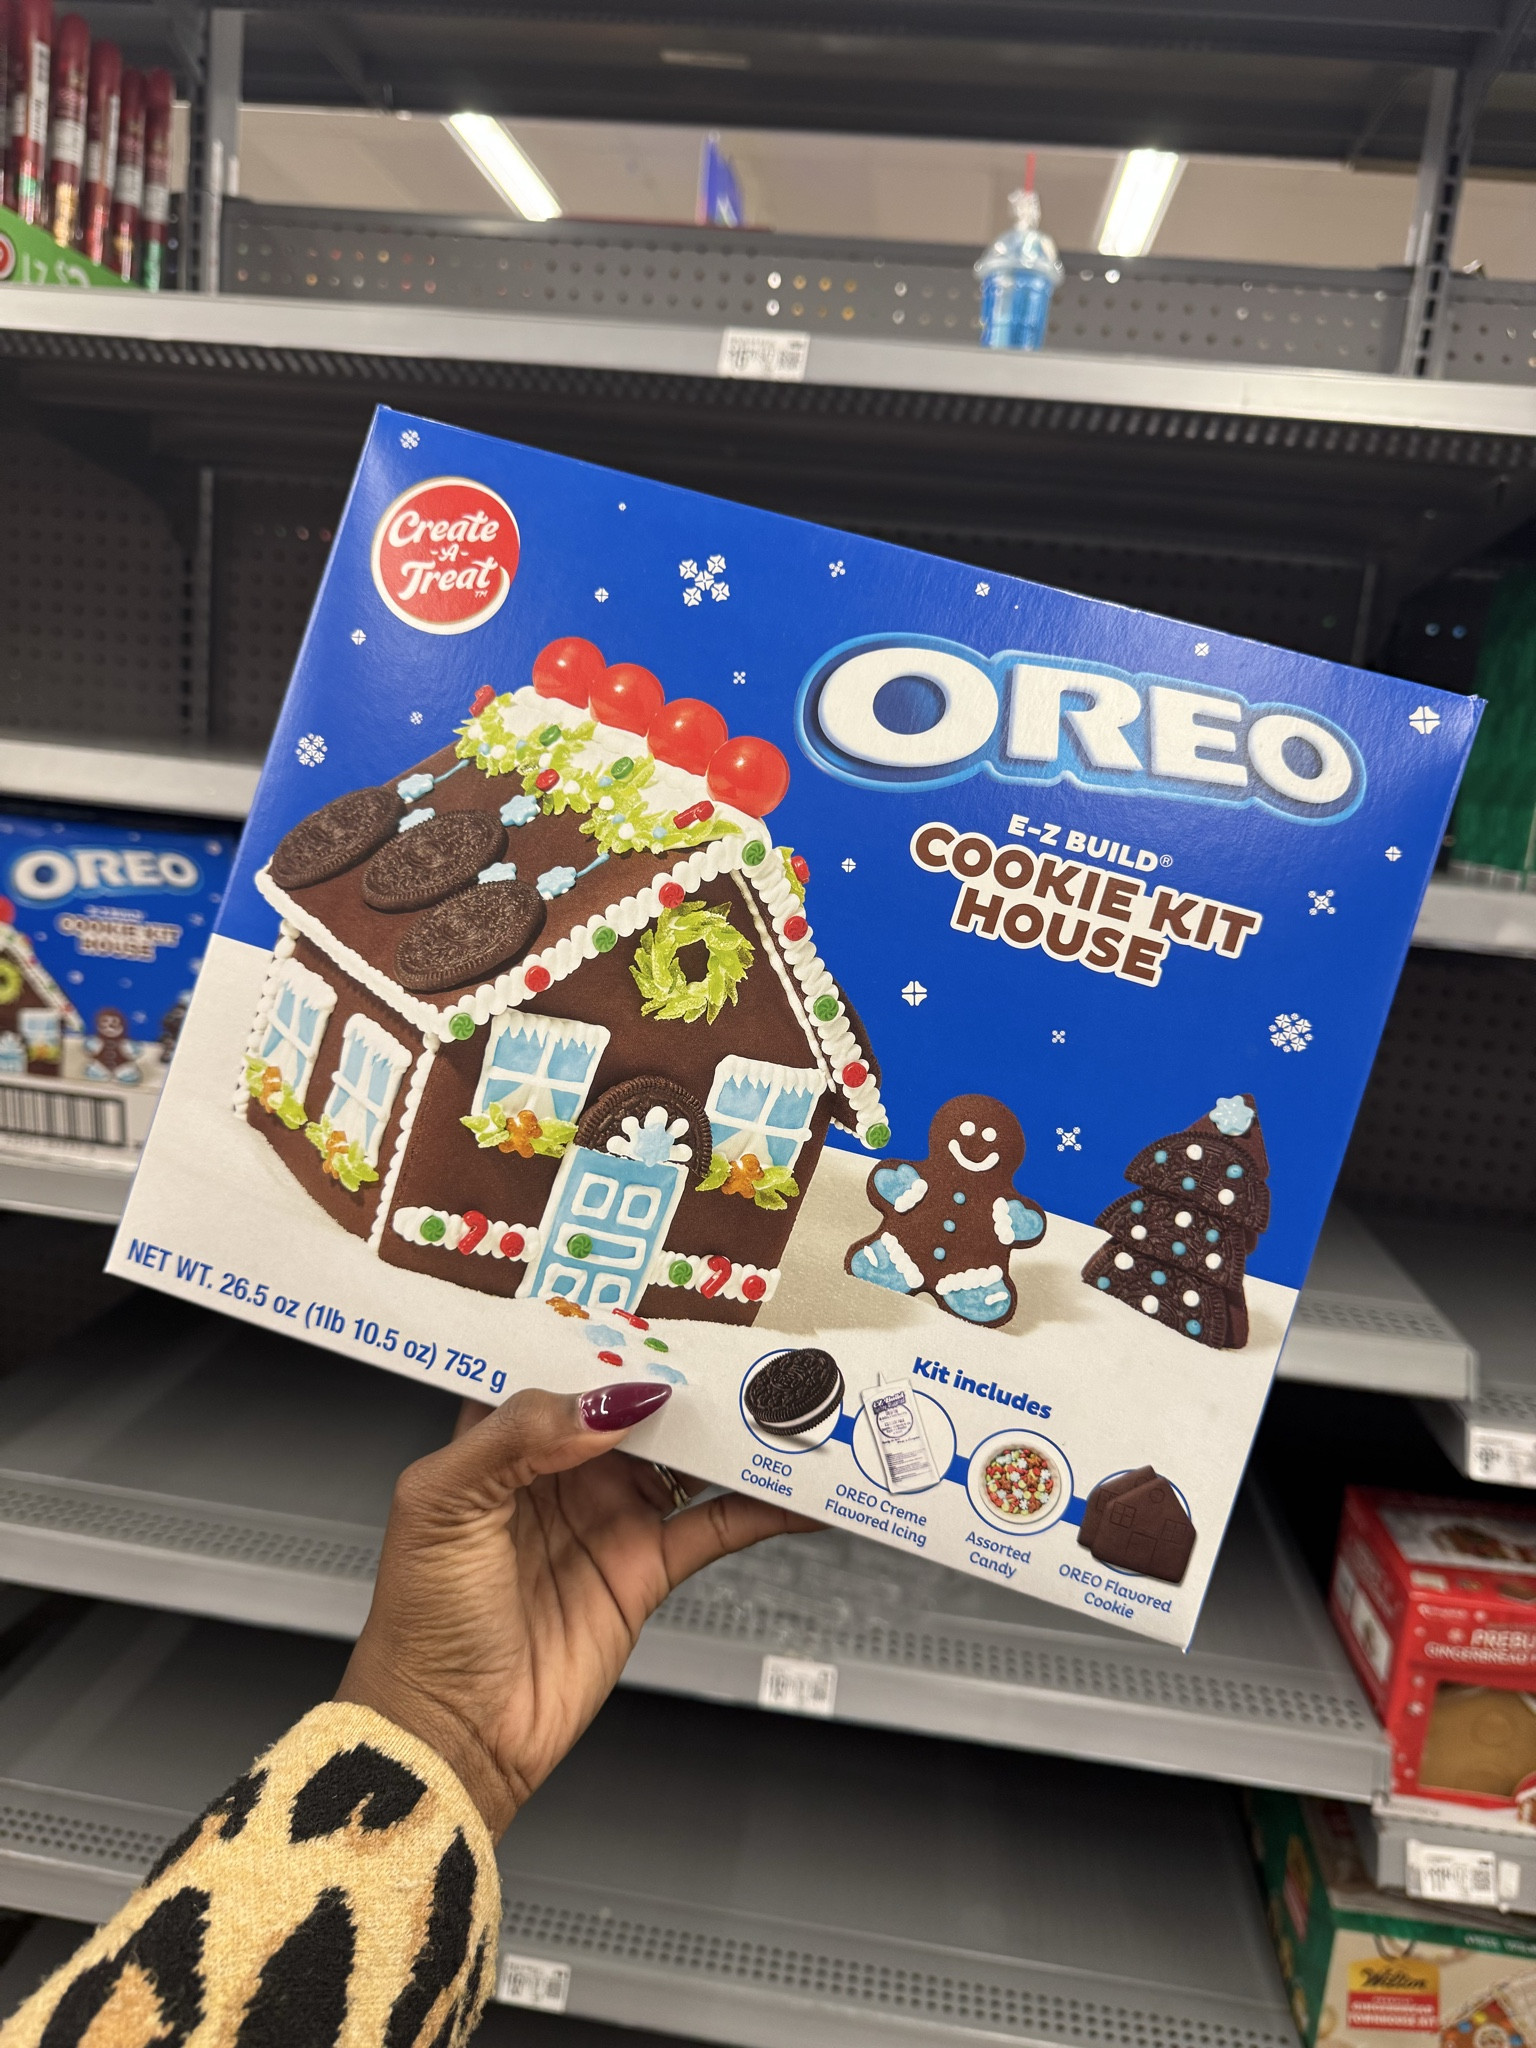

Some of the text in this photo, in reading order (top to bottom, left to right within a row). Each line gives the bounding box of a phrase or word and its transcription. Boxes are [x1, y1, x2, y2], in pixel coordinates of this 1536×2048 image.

[388, 510, 500, 548] Create
[397, 555, 499, 601] Treat
[817, 646, 1354, 805] OREO
[1007, 813, 1062, 846] E-Z
[13, 849, 198, 899] OREO
[914, 826, 1258, 954] COOKIE KIT
[955, 885, 1166, 982] HOUSE
[127, 1239, 508, 1394] NET WT. 26.5 oz (1lb 10.5 oz) 752 g
[912, 1357, 1053, 1420] Kit includes
[740, 1469, 793, 1497] Cookies
[751, 1453, 793, 1477] OREO
[824, 1498, 928, 1549] Flavored Icing
[835, 1483, 928, 1526] OREO Creme
[964, 1531, 1032, 1564] Assorted
[969, 1551, 1018, 1579] Candy
[1058, 1563, 1173, 1613] OREO Flavored
[1083, 1591, 1135, 1619] Cookie
